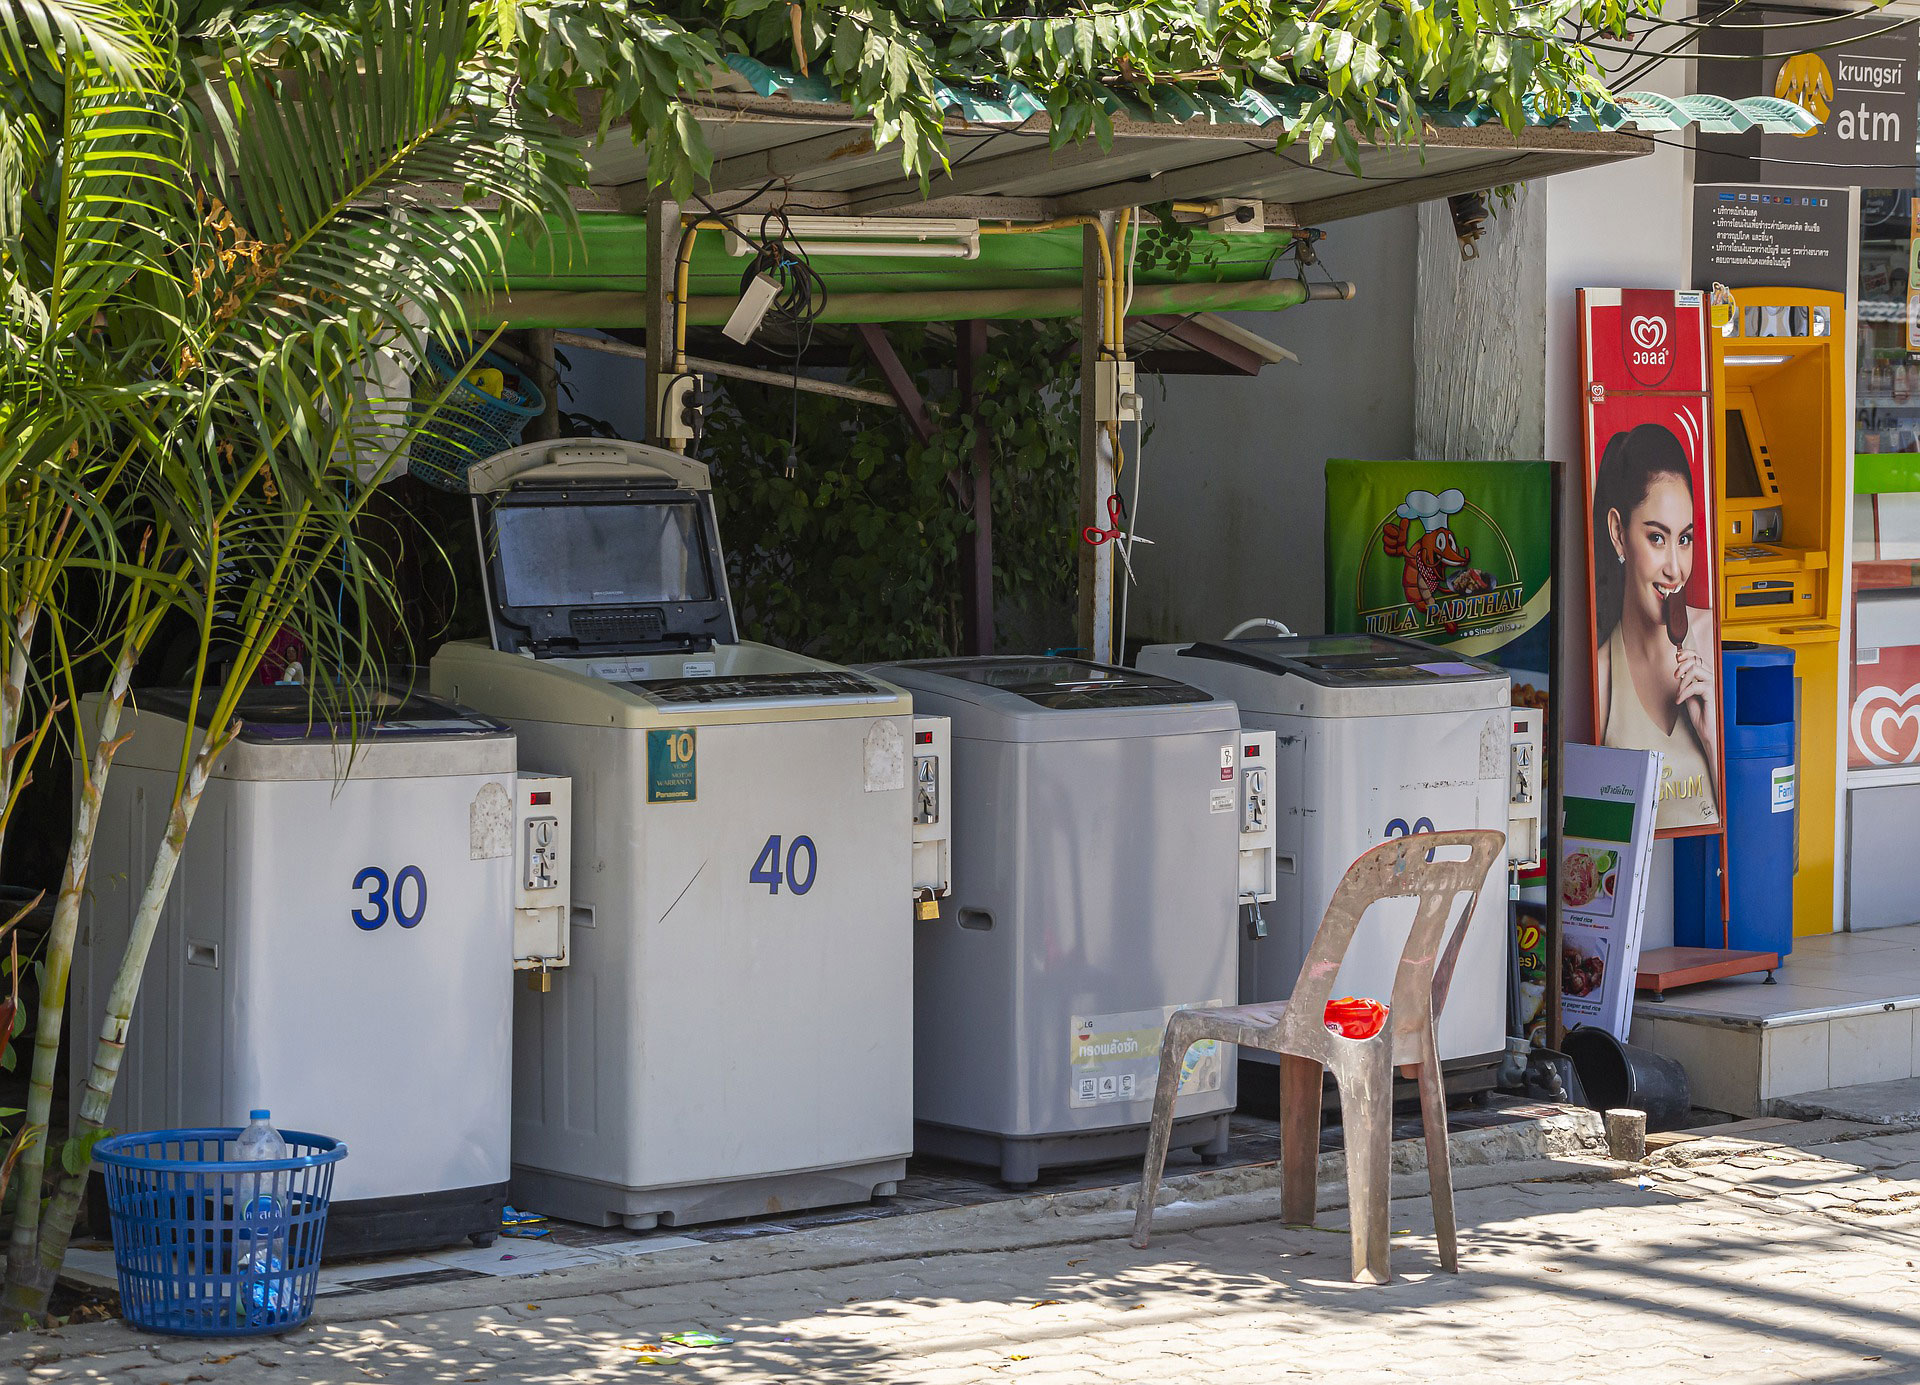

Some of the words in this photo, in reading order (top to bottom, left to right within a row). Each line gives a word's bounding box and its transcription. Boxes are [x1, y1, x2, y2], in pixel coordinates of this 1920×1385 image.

[1838, 60, 1902, 88] krungsri
[1837, 103, 1900, 142] atm
[1633, 347, 1667, 365] วอลล์
[1425, 588, 1523, 627] PADTHAI
[1474, 627, 1493, 636] Since
[666, 733, 694, 762] 10
[749, 834, 818, 896] 40
[351, 864, 428, 931] 30
[1084, 1020, 1093, 1028] LG
